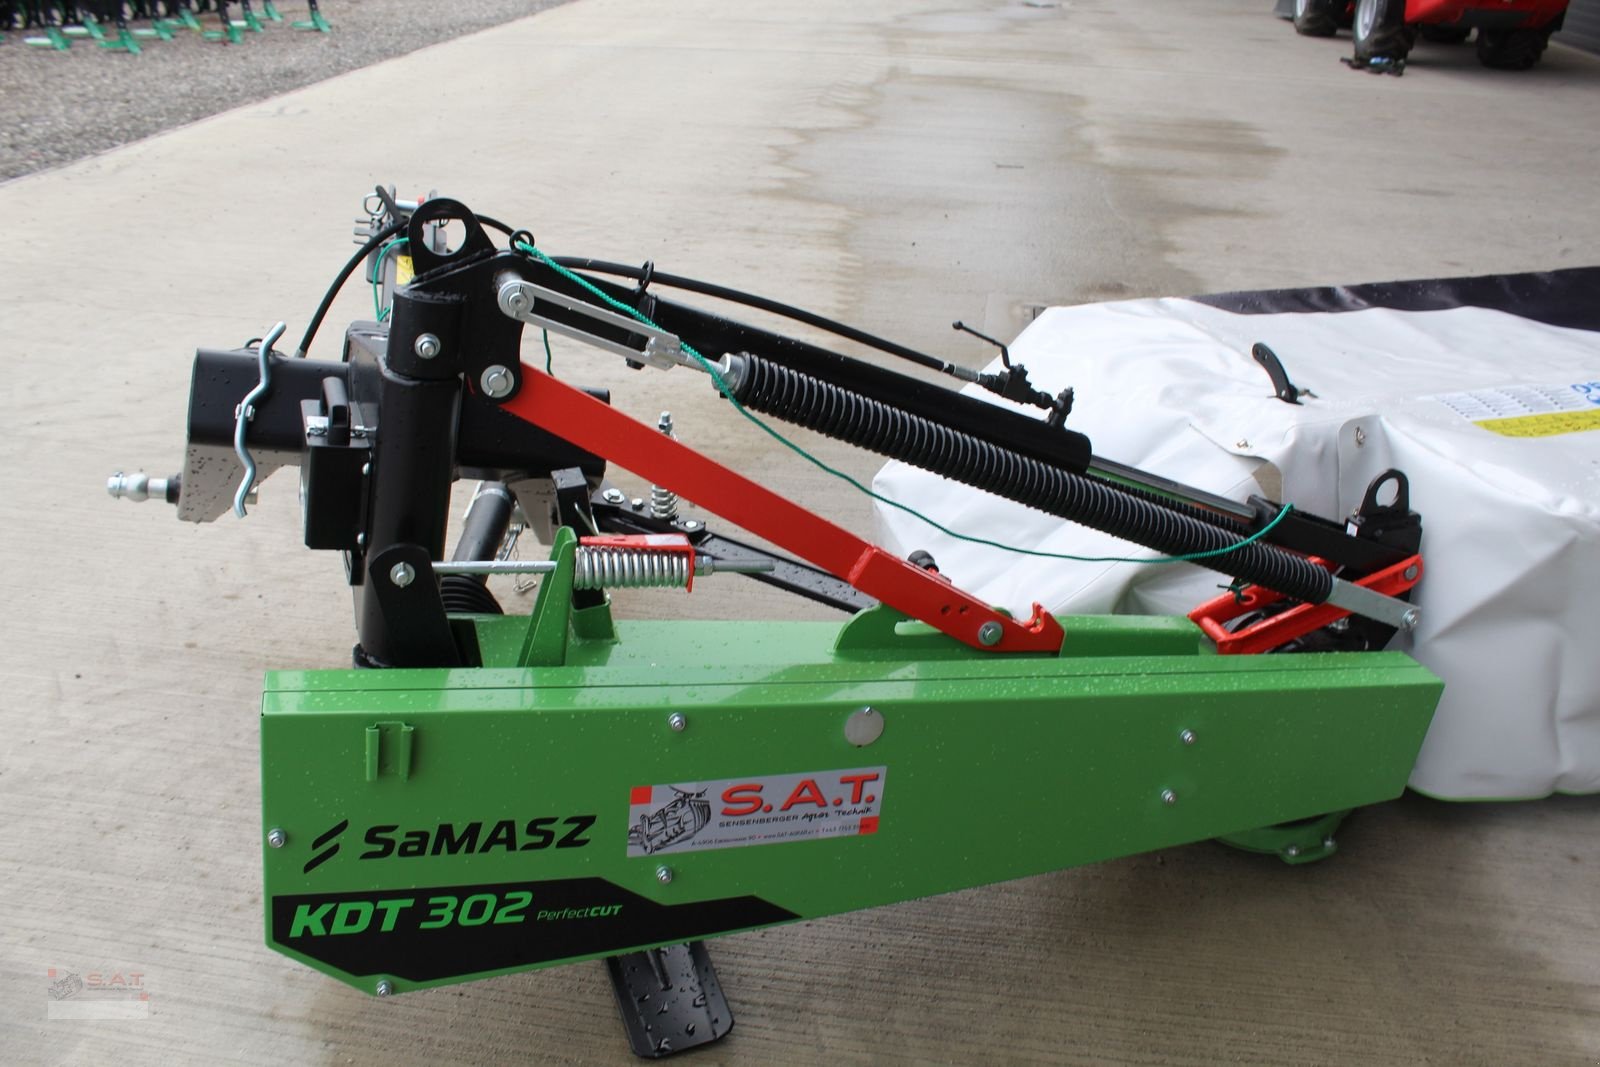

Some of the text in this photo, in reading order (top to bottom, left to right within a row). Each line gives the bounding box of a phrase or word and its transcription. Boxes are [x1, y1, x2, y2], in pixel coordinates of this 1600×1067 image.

[719, 815, 799, 828] SENSENBERGER
[834, 805, 873, 817] Technik
[720, 773, 880, 816] S.A.T.
[359, 815, 597, 860] SaMASZ
[289, 891, 624, 938] KDT 302 PerfectCUT
